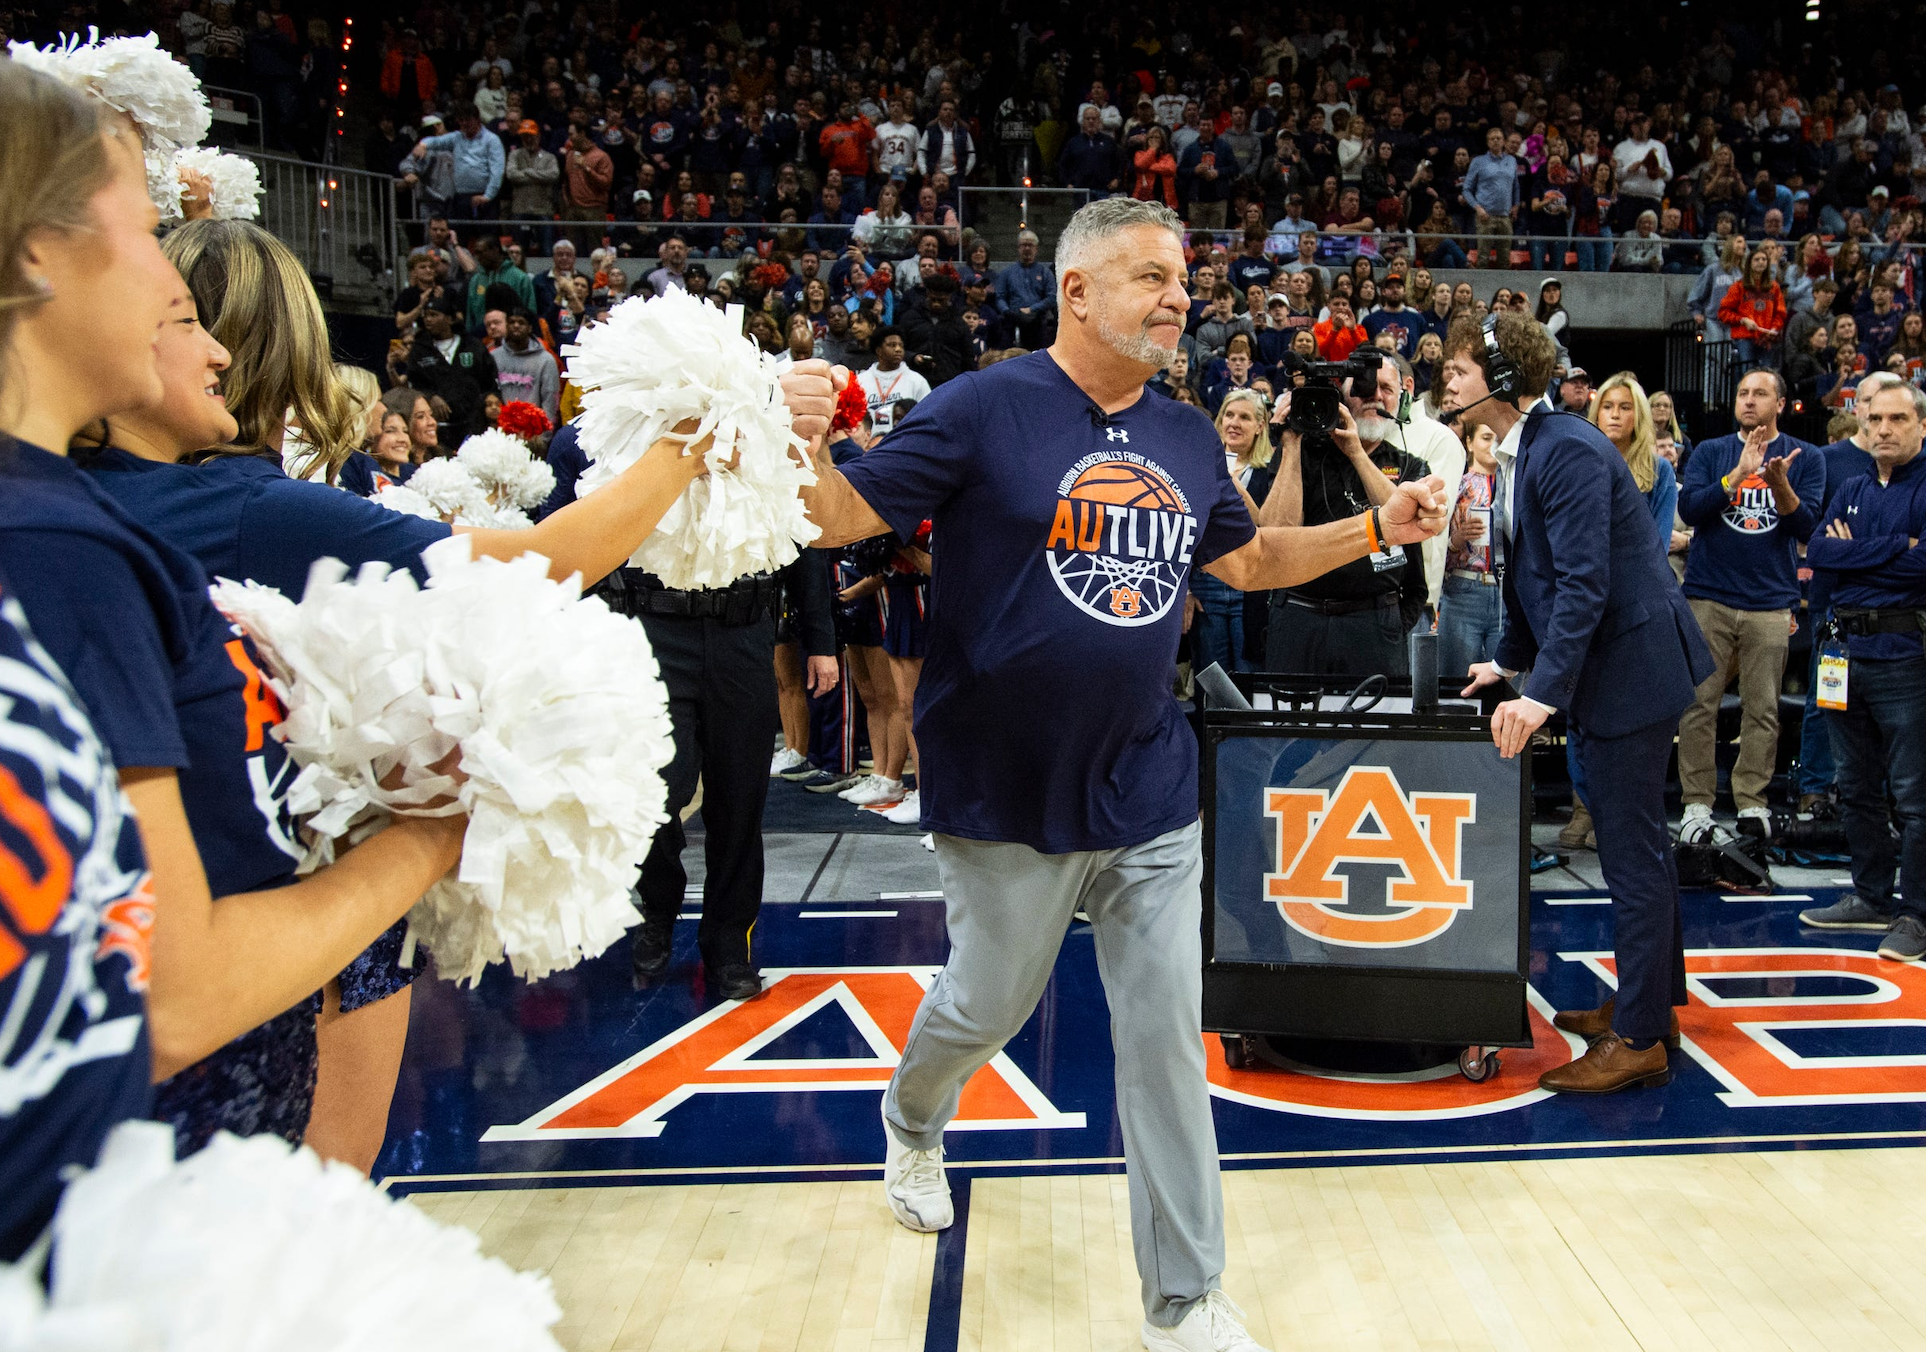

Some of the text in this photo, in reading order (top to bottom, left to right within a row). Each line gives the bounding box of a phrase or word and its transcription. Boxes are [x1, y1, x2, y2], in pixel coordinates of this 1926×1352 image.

[888, 141, 905, 155] 34
[1057, 450, 1192, 514] AUBURN BASKETBALL'S FIGHT AGAINST CANCER
[1046, 499, 1198, 564] AUTLIVE
